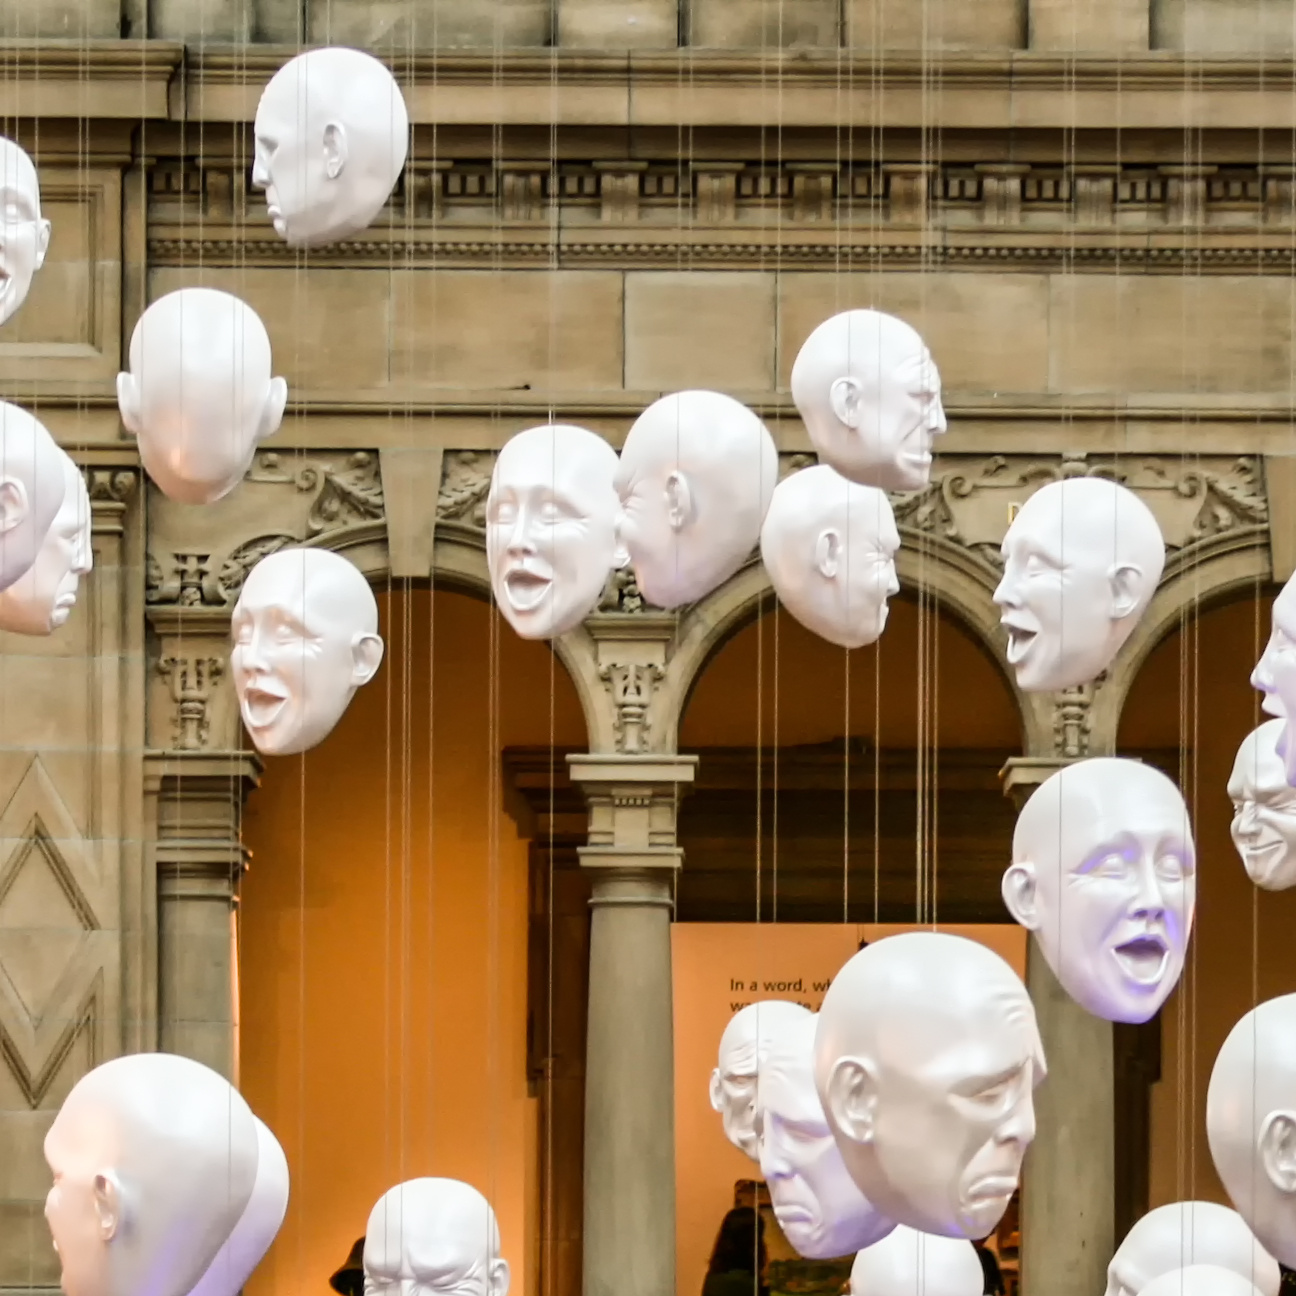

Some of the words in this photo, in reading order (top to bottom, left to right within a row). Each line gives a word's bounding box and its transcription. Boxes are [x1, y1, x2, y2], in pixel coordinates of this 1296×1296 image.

[730, 978, 745, 992] In
[749, 981, 758, 992] a
[762, 977, 807, 994] word,
